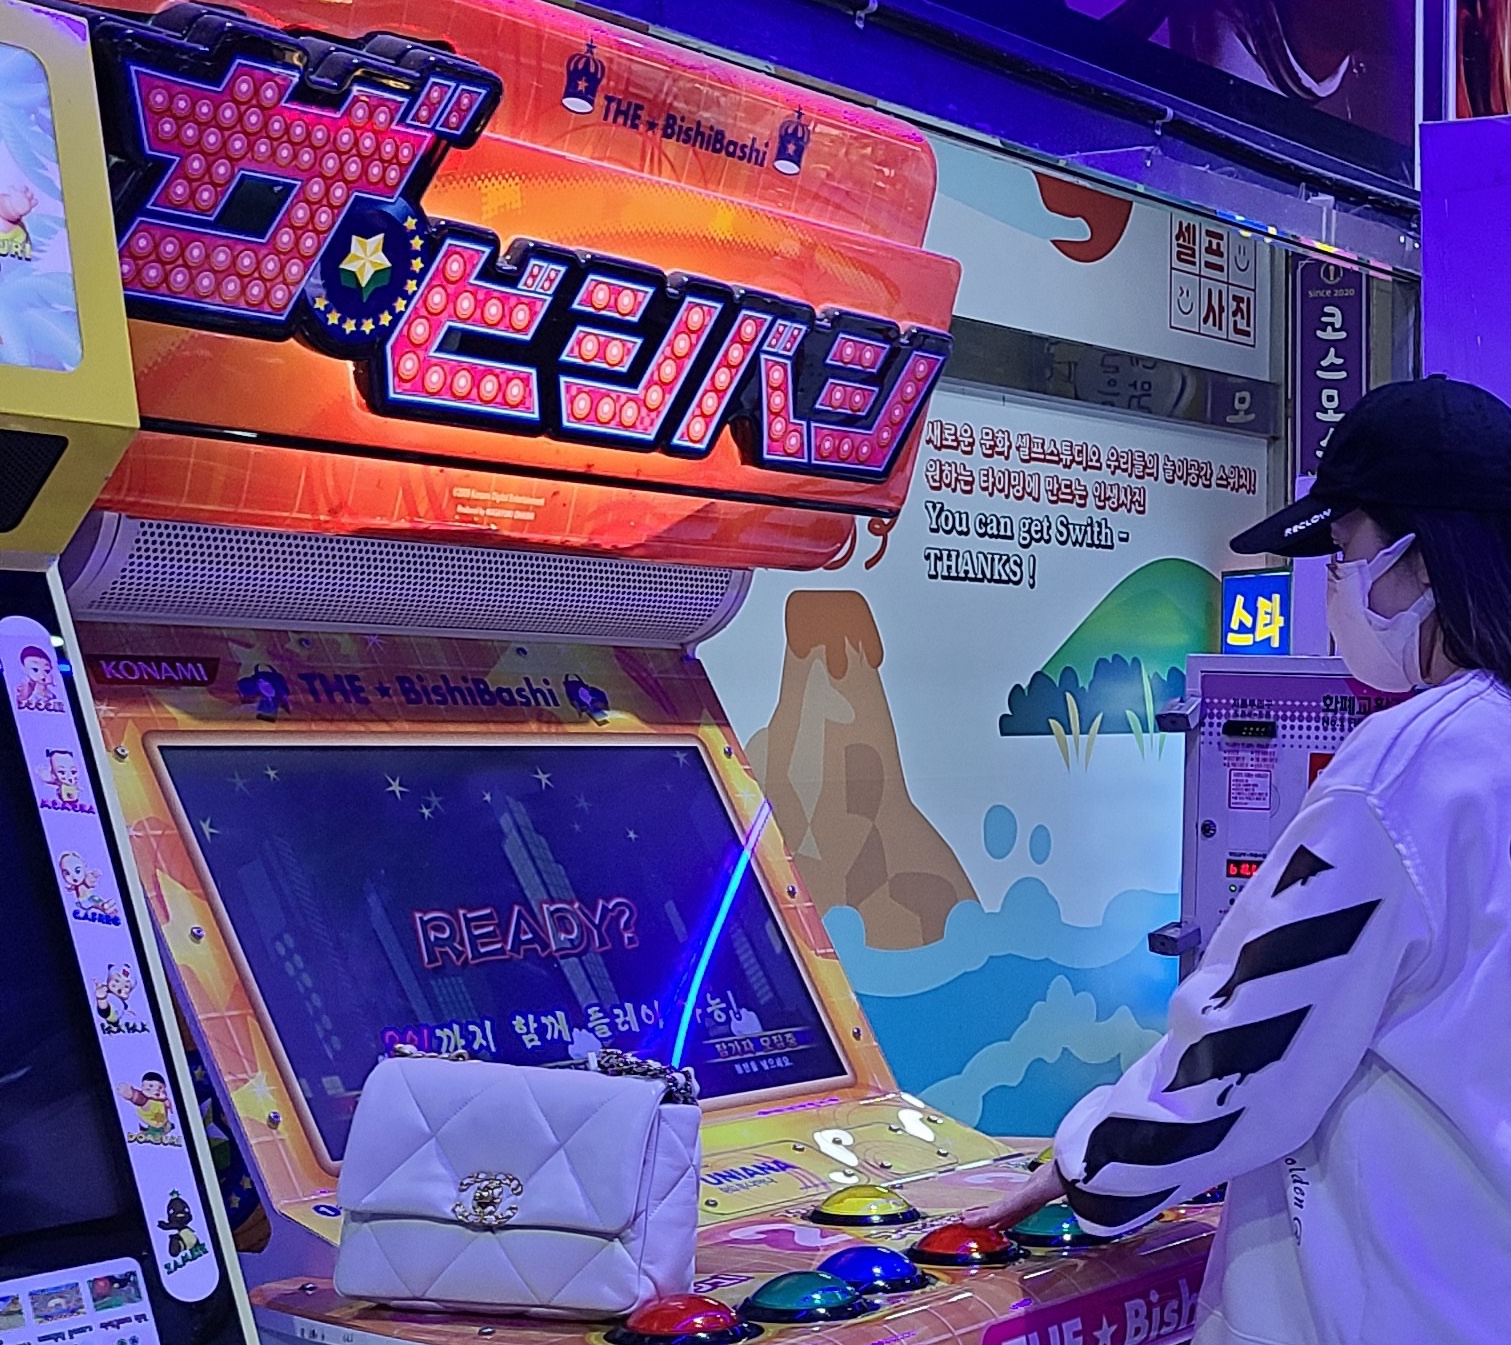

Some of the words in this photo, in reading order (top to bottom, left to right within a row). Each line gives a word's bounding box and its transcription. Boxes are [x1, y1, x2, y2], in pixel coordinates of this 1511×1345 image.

[603, 94, 645, 131] THE
[661, 113, 770, 168] BishiBashi
[1175, 219, 1225, 273] 셀프
[1203, 288, 1252, 339] 사진
[1308, 288, 1331, 298] since
[1333, 288, 1355, 298] 2020
[926, 420, 974, 452] 새로운
[979, 426, 1010, 457] 문화
[1106, 447, 1158, 479] 우리들의
[1163, 455, 1212, 485] 놀이공간
[925, 459, 974, 493] 원하는
[979, 467, 1039, 502] 타이밍에
[1044, 476, 1088, 506] 만드는
[1093, 481, 1147, 514] 인생사진
[926, 502, 970, 536] You
[975, 514, 1014, 540] can
[1019, 516, 1050, 548] get
[925, 548, 1025, 586] THANKS
[1226, 592, 1285, 649] 스타
[100, 660, 209, 683] KONAMI
[300, 673, 375, 707] THE
[399, 674, 562, 709] BishiBashi
[413, 896, 640, 969] READY?
[700, 1159, 794, 1186] UNIANA
[1284, 1156, 1311, 1210] olden
